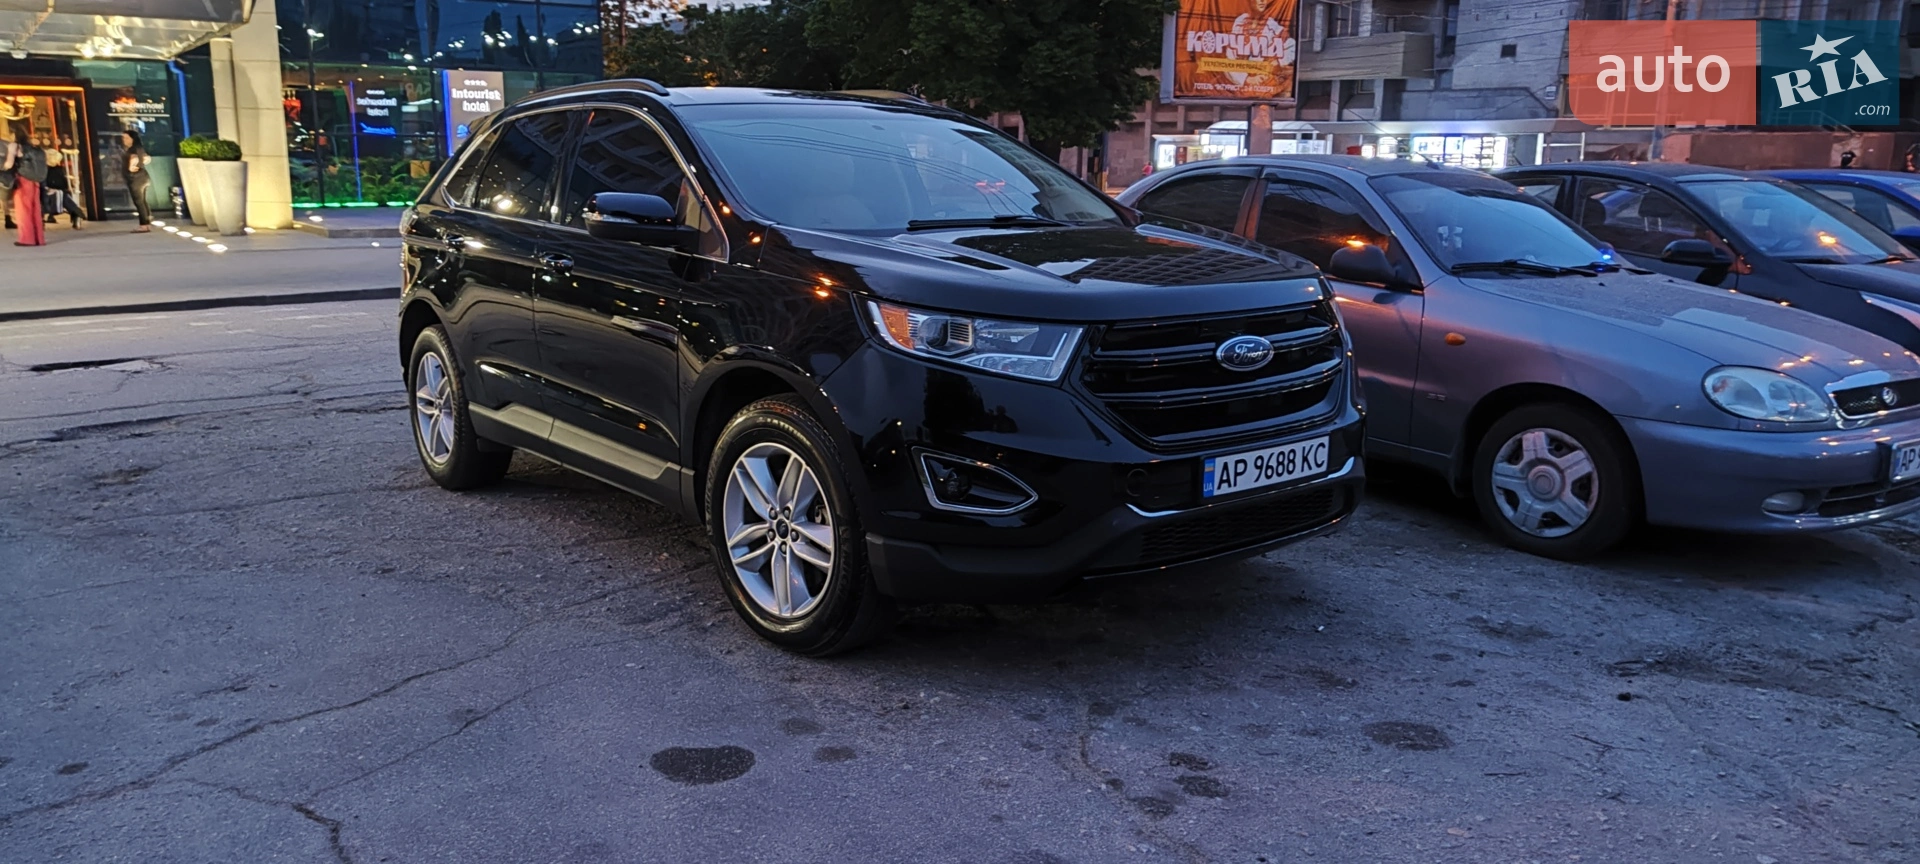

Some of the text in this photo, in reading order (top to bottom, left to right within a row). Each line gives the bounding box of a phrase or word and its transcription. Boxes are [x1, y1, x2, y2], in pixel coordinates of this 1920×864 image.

[1187, 30, 1284, 57] КОРЧМА
[452, 88, 501, 100] Intourist
[462, 100, 490, 112] hotel
[1216, 442, 1326, 490] AP 9688 KC
[1203, 482, 1214, 492] UA
